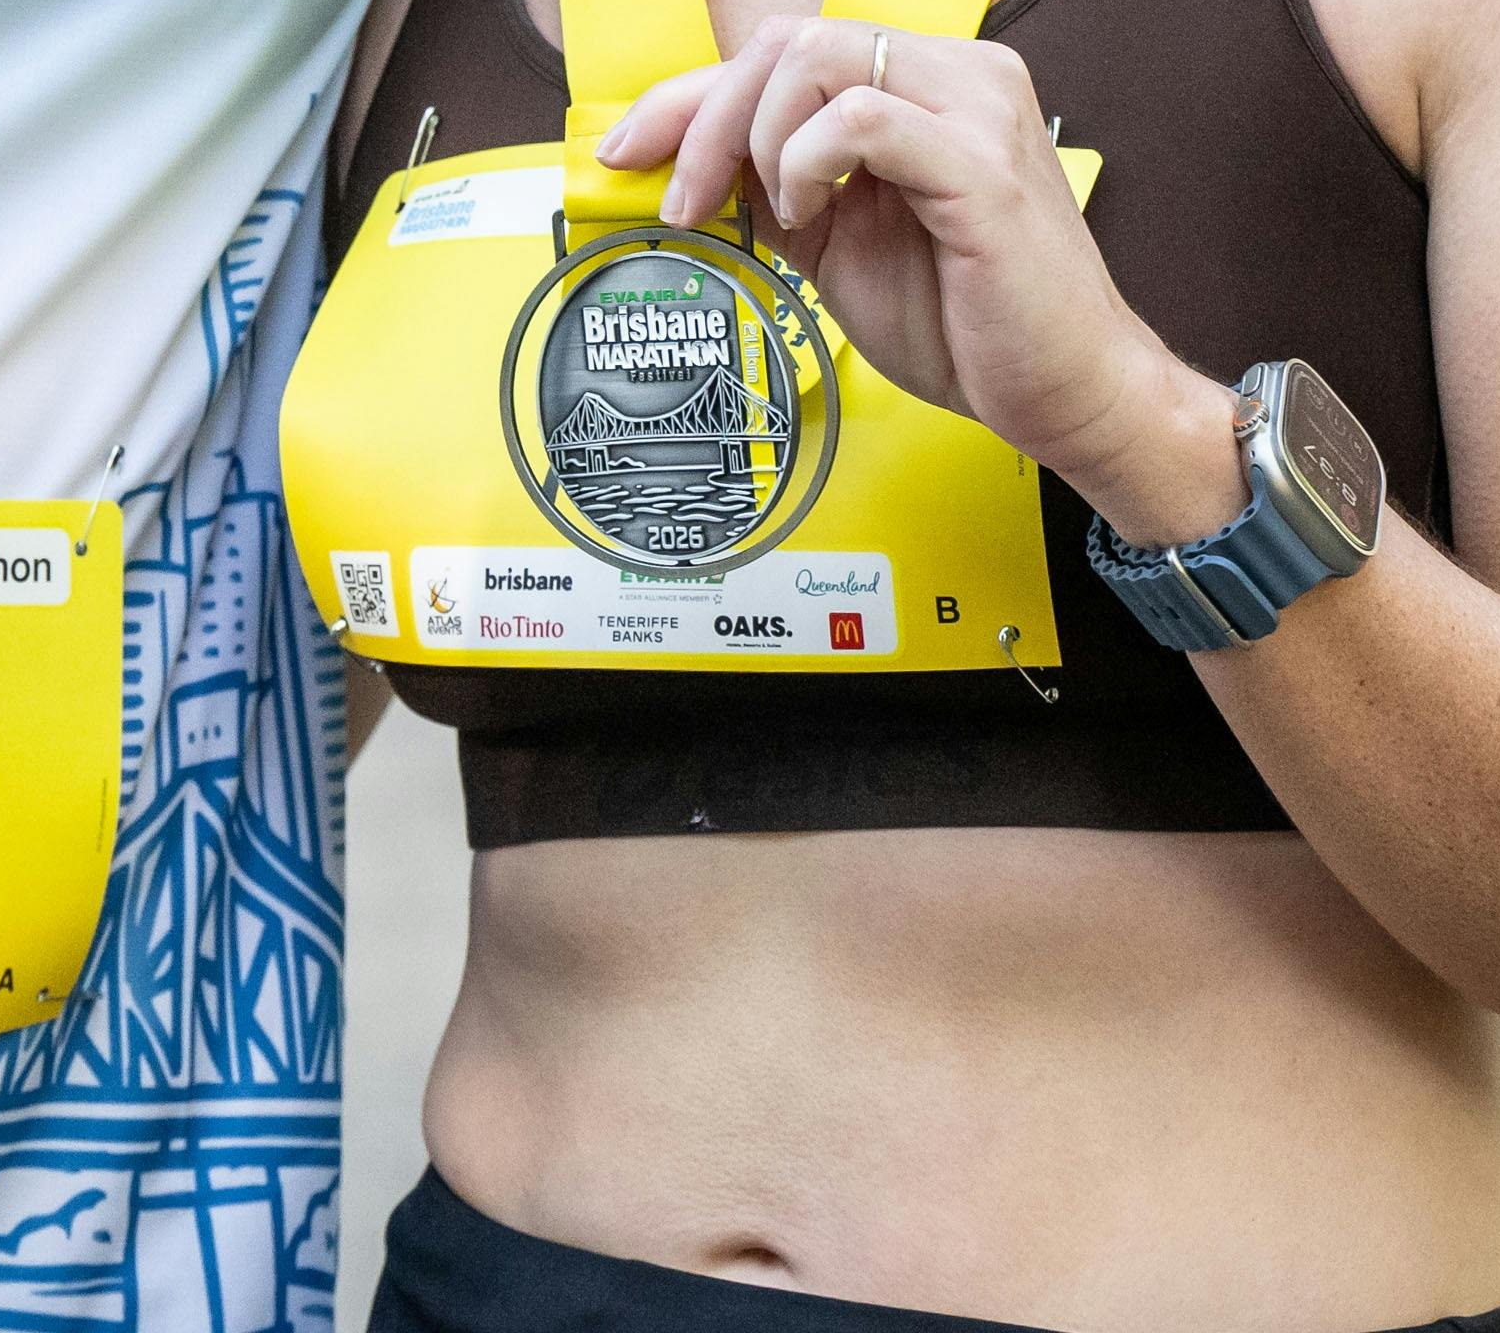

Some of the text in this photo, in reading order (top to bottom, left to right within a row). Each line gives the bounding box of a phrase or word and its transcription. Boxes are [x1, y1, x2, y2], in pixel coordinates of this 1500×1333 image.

[601, 289, 676, 304] EVA AIR
[583, 304, 727, 344] Brisbane
[586, 340, 730, 371] MARATHON
[629, 367, 692, 382] Festival
[647, 525, 704, 551] 2026
[485, 567, 573, 592] brisbane
[796, 568, 880, 596] Queensland
[679, 595, 710, 603] MEMBER
[936, 596, 961, 625] B
[428, 615, 462, 628] ATLAS
[480, 615, 565, 639] RioTinto
[598, 615, 680, 631] TENERIFFE
[713, 615, 793, 638] OAKS.
[612, 630, 664, 644] BANKS
